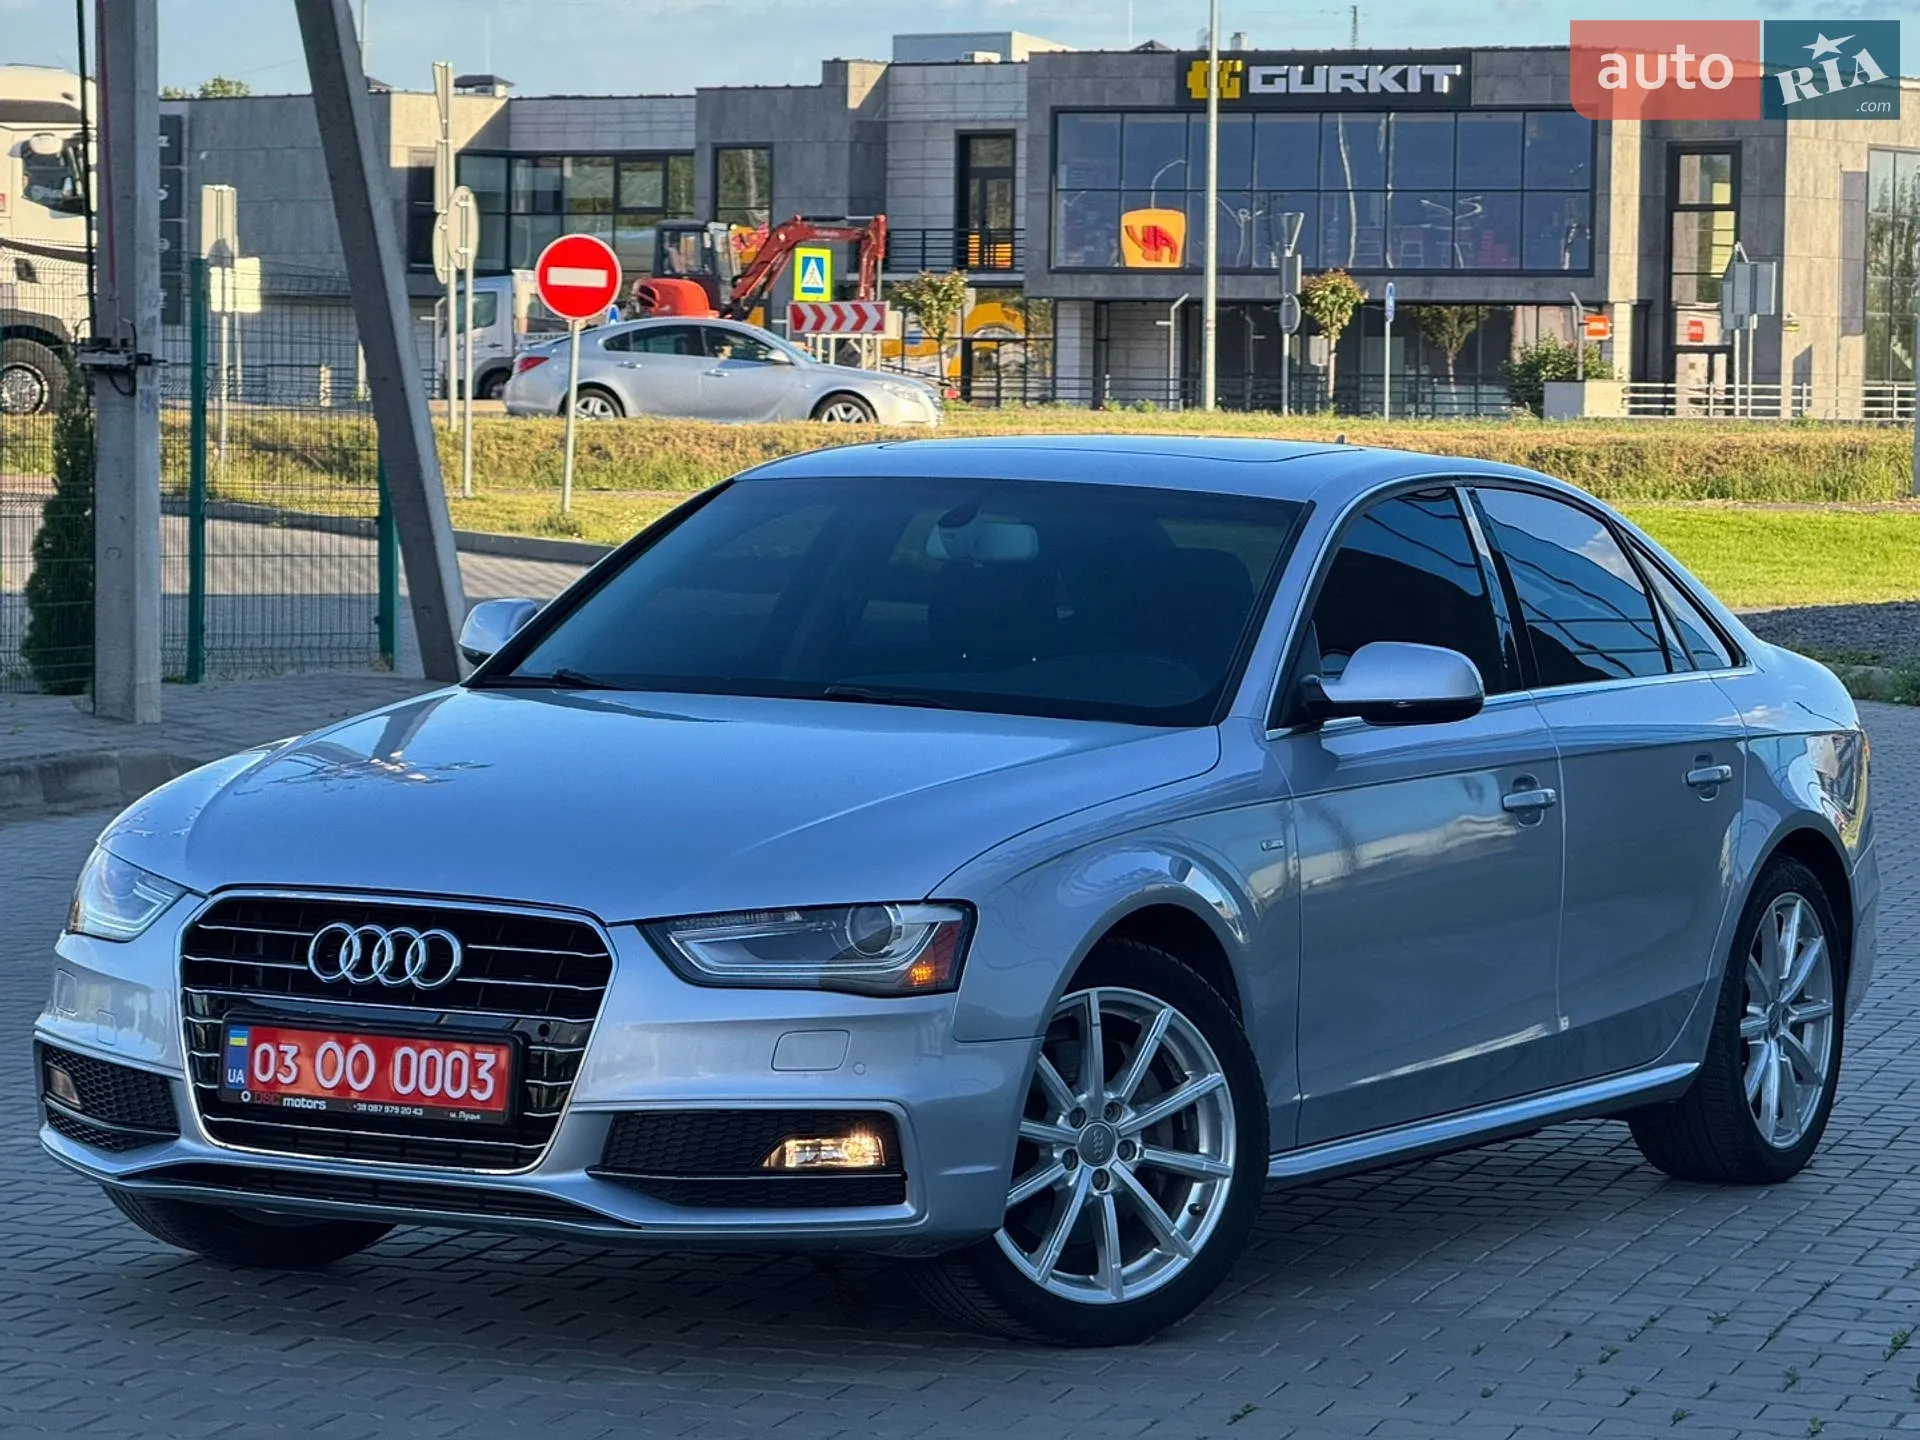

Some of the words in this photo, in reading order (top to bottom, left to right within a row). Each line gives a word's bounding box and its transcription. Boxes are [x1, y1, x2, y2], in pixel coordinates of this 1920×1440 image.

[1250, 65, 1461, 93] GURKIT
[227, 1068, 245, 1083] UA
[254, 1042, 298, 1084] 03
[393, 1046, 496, 1101] 0003
[282, 1097, 327, 1110] motors
